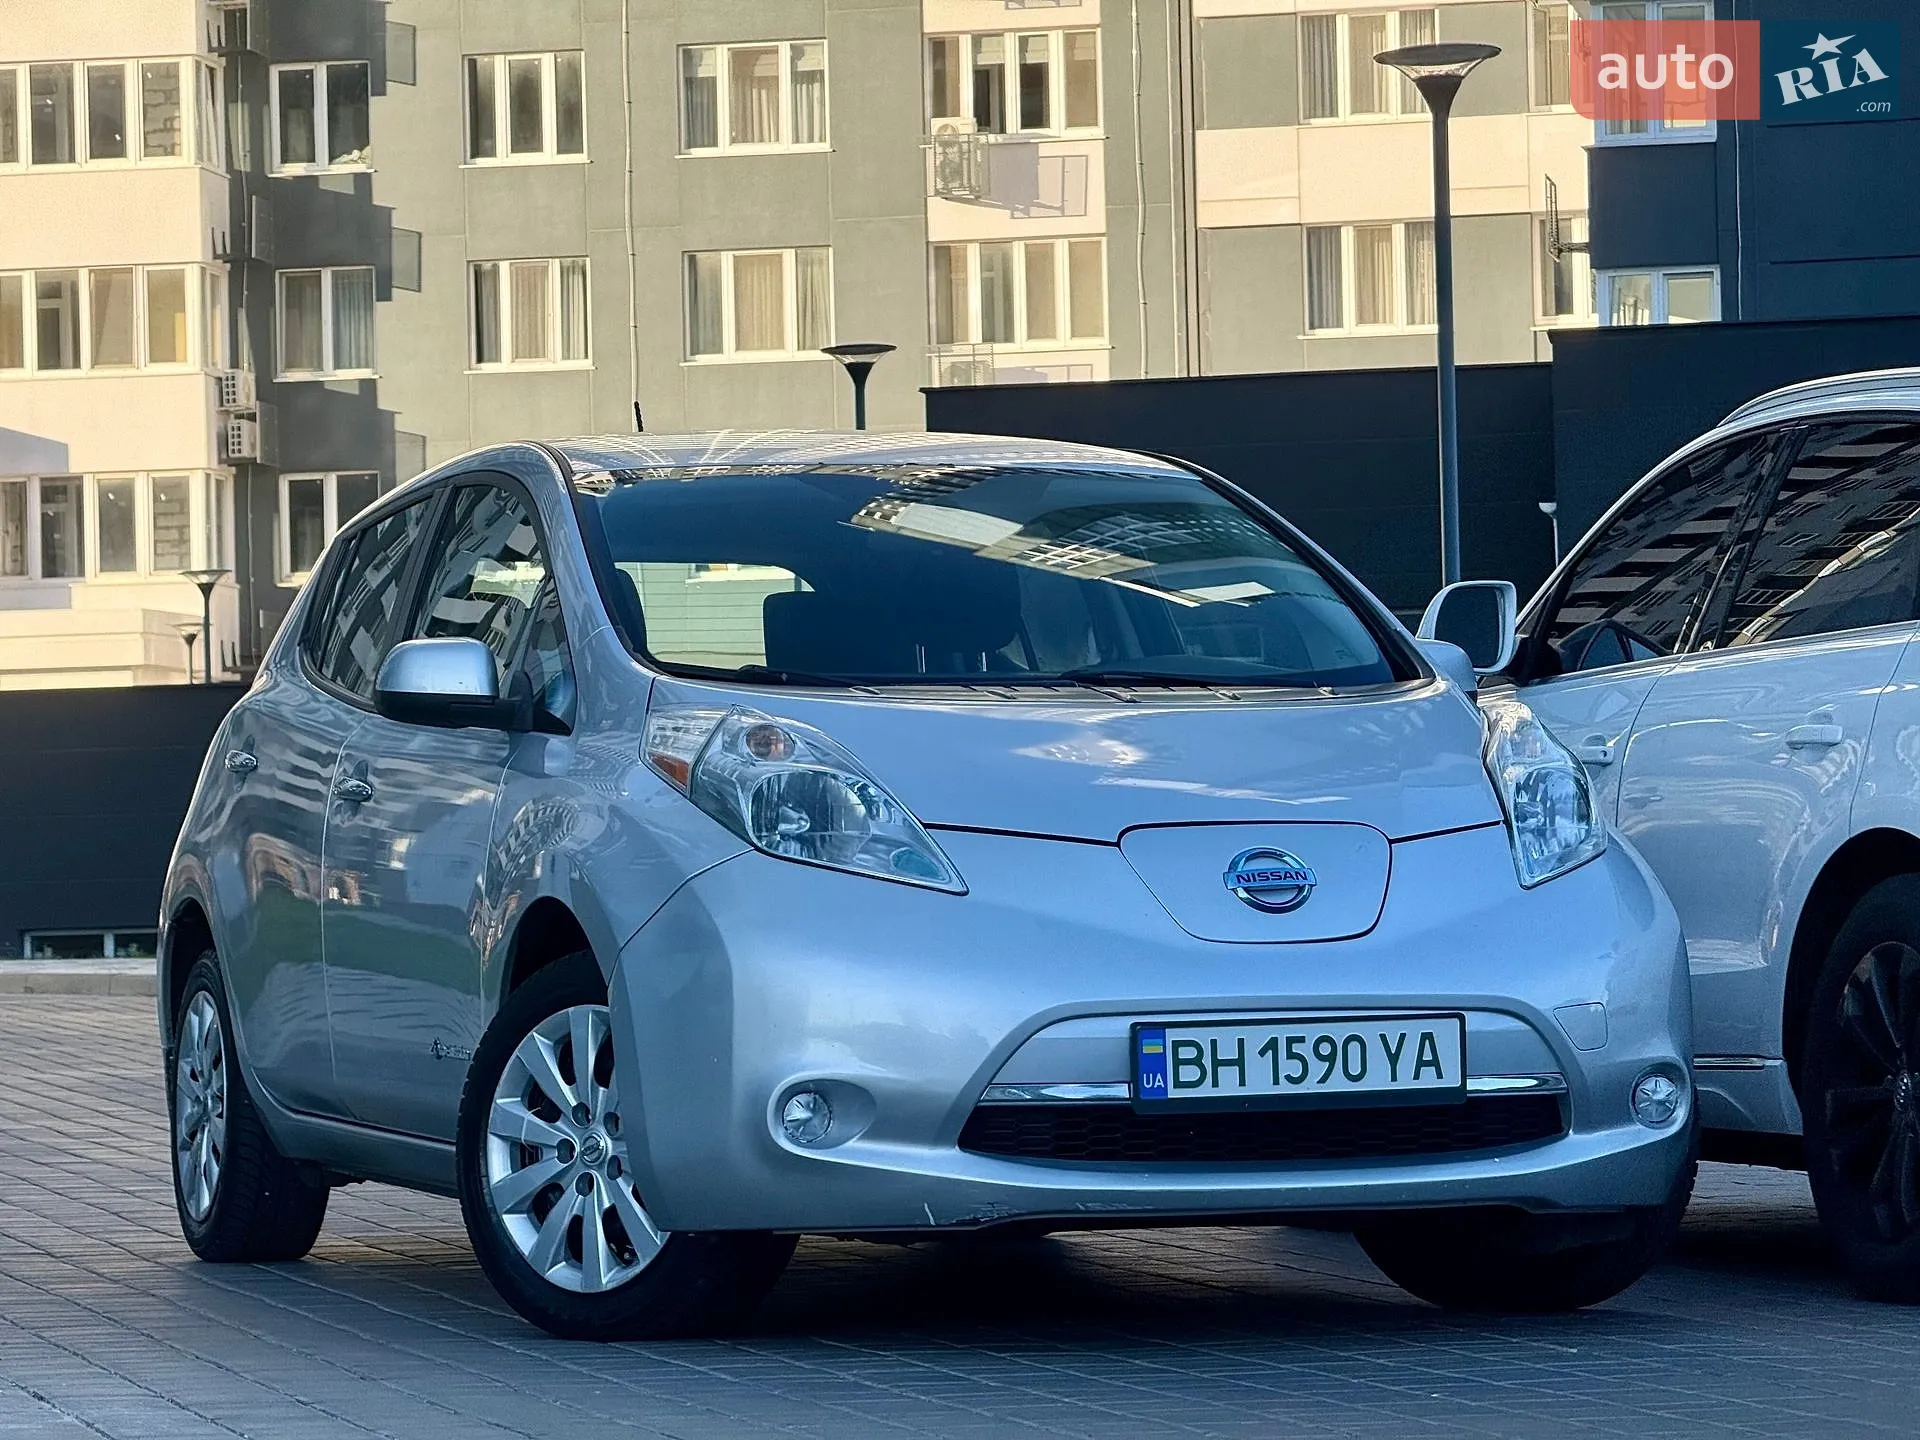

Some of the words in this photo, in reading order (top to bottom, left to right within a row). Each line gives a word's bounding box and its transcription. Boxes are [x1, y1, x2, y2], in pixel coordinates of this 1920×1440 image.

[1235, 871, 1308, 884] NISSAN
[1171, 1037, 1246, 1089] BH
[1257, 1033, 1368, 1086] 1590
[1379, 1031, 1444, 1083] YA
[1143, 1073, 1165, 1088] UA
